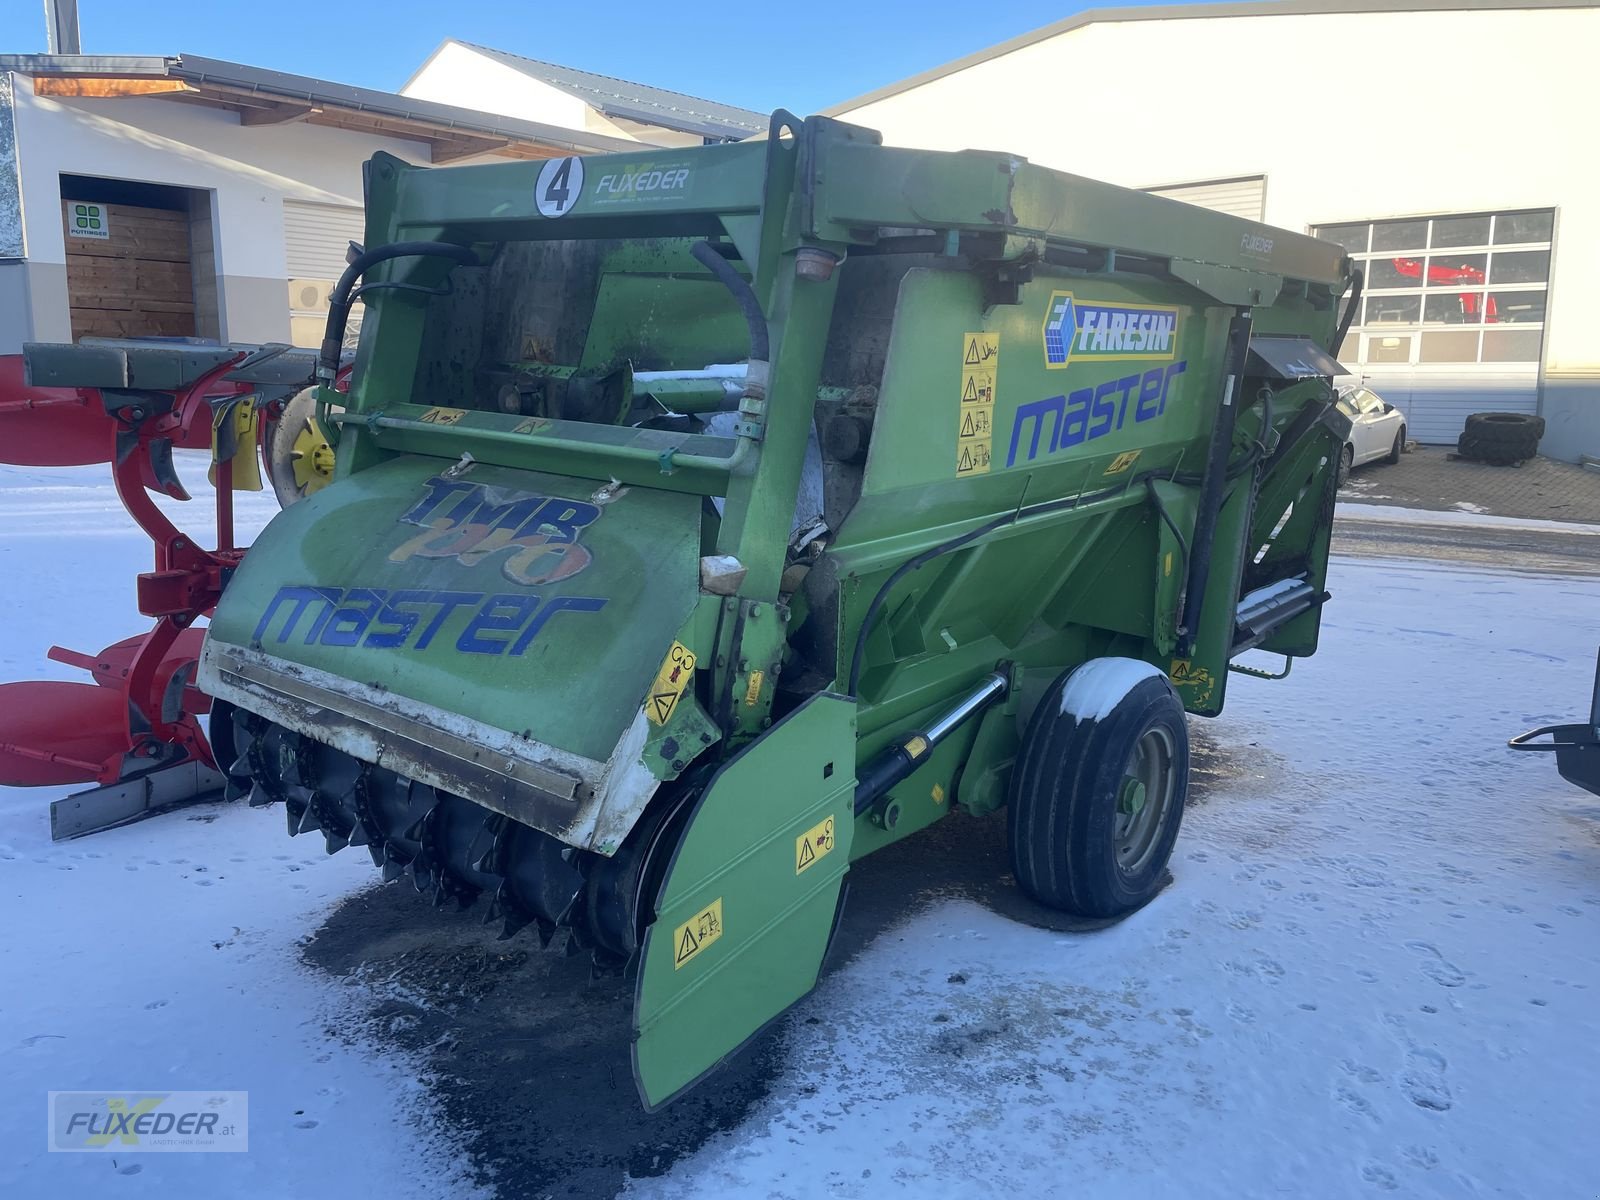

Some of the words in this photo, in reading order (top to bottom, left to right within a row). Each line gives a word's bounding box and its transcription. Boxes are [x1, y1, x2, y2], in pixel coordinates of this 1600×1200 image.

[544, 156, 573, 211] 4
[595, 169, 690, 194] FLIXEDER
[1079, 311, 1173, 351] FARESIN
